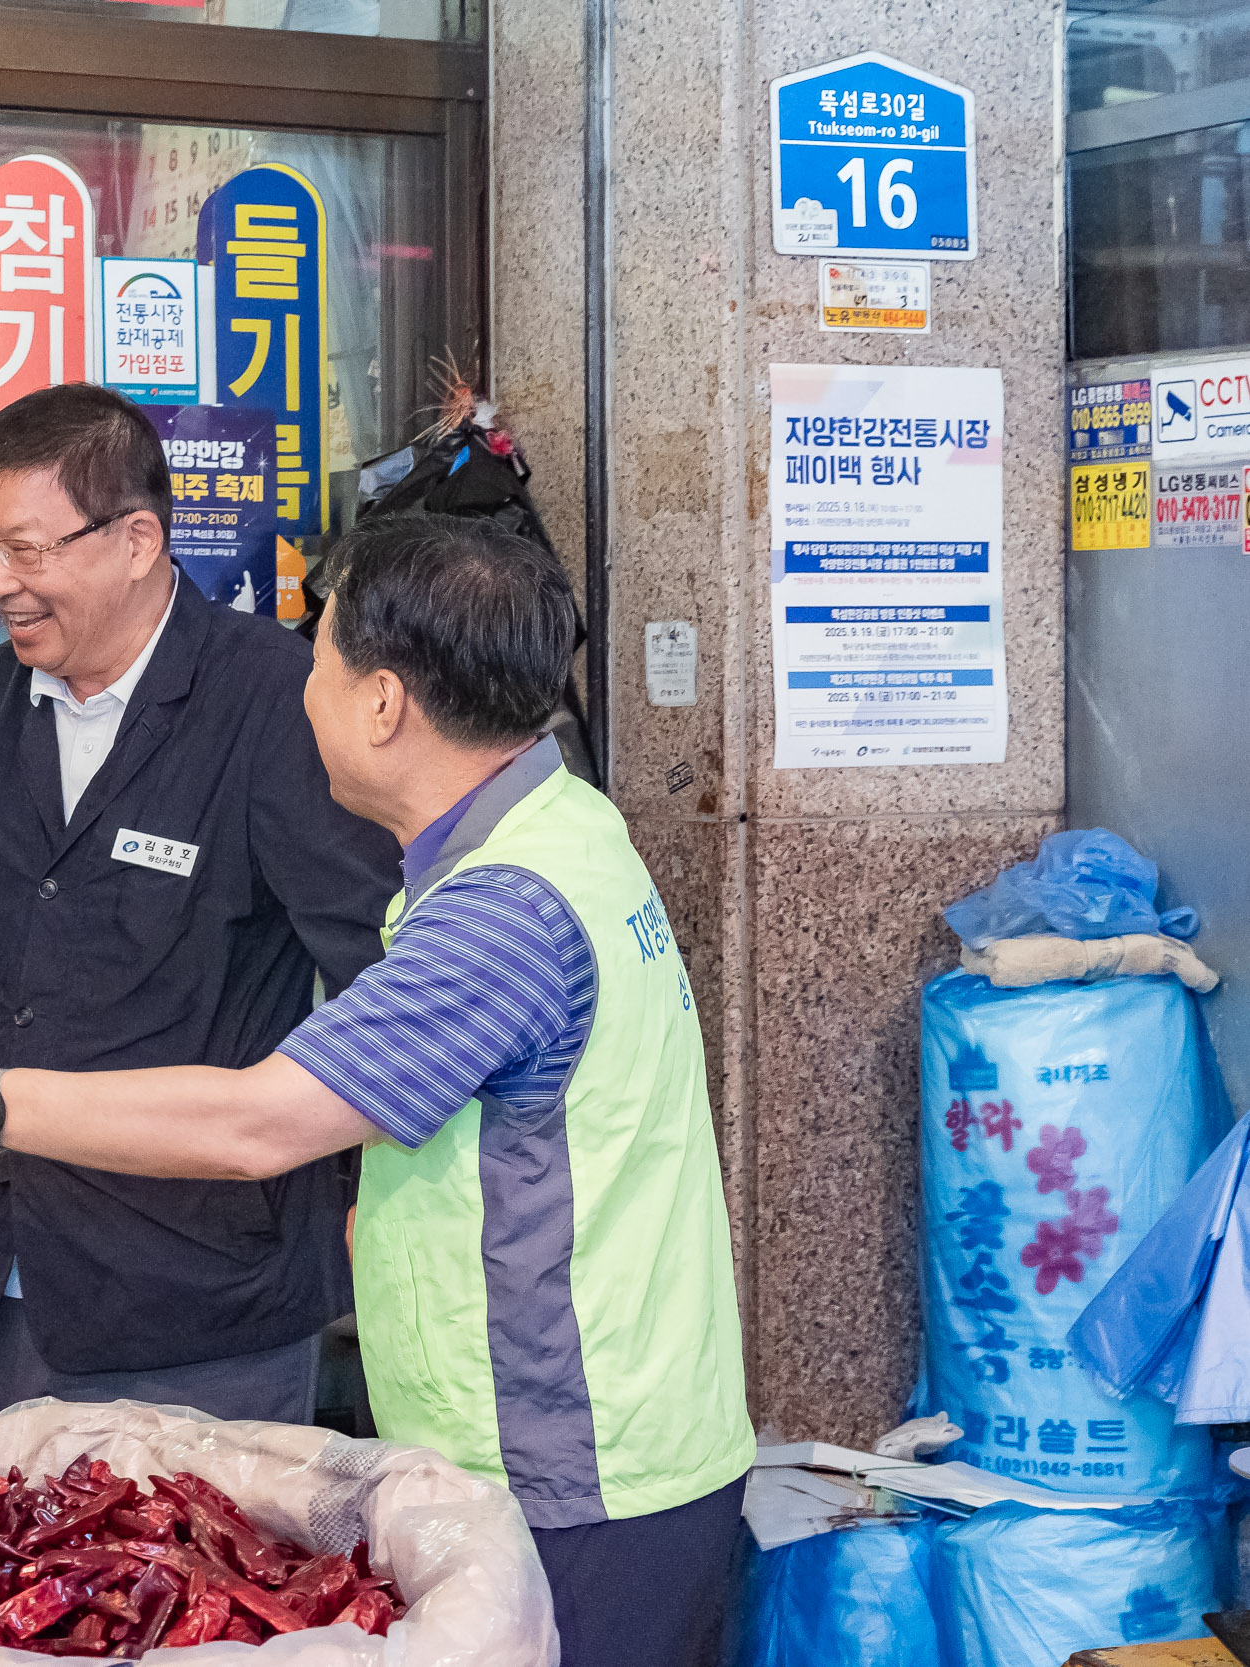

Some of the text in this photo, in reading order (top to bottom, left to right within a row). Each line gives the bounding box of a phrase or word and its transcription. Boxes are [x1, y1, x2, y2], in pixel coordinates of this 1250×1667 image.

[818, 90, 926, 122] 뚝섬로30길
[808, 120, 939, 143] Ttukseom-ro 30-gil
[169, 149, 177, 171] 8
[190, 141, 198, 164] 9
[208, 132, 221, 157] 10
[836, 157, 918, 230] 16
[143, 191, 200, 231] 14 15 16
[116, 303, 184, 325] 전통시장
[117, 327, 184, 348] 화재공제
[118, 353, 185, 375] 가입점포
[785, 416, 990, 449] 자양한강전통시장
[785, 455, 922, 486] 페이백 행사
[216, 473, 264, 502] 축제
